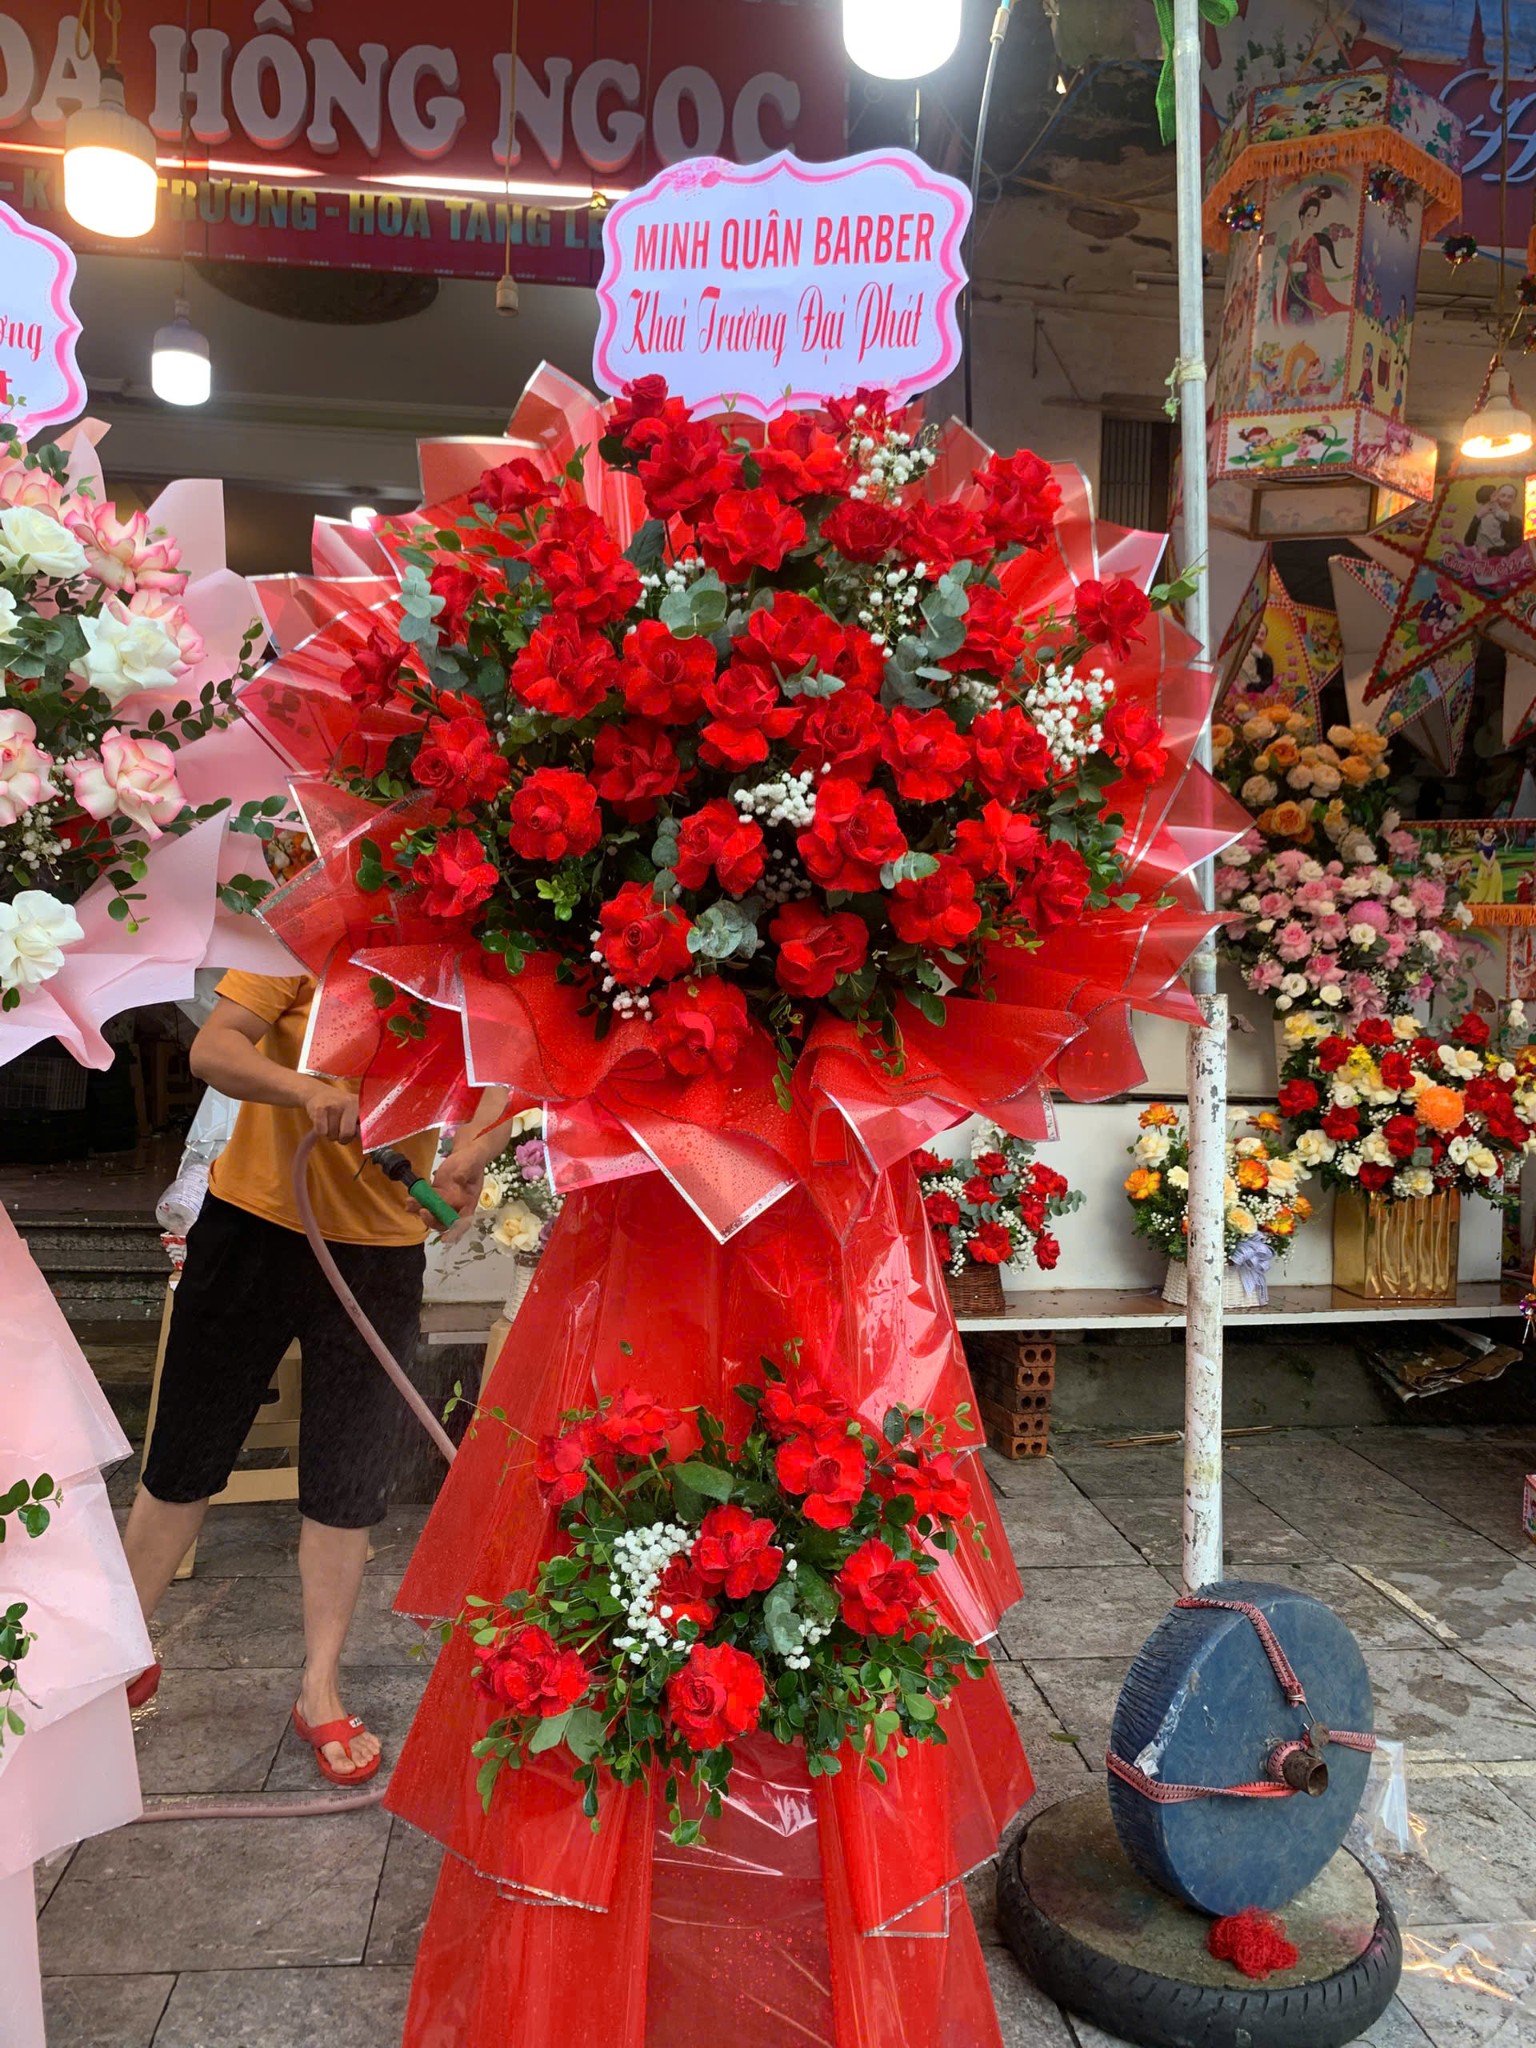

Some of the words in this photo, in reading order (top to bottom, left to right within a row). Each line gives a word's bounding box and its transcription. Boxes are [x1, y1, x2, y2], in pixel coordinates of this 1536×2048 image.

[349, 190, 431, 239] HOA
[445, 194, 550, 247] TANG
[633, 221, 710, 272] MINH
[720, 209, 803, 272] QUÂN
[813, 213, 935, 266] BARBER
[622, 288, 687, 354] Khai
[697, 286, 787, 368] Trương
[796, 285, 846, 365] Đại
[855, 281, 925, 365] Phát
